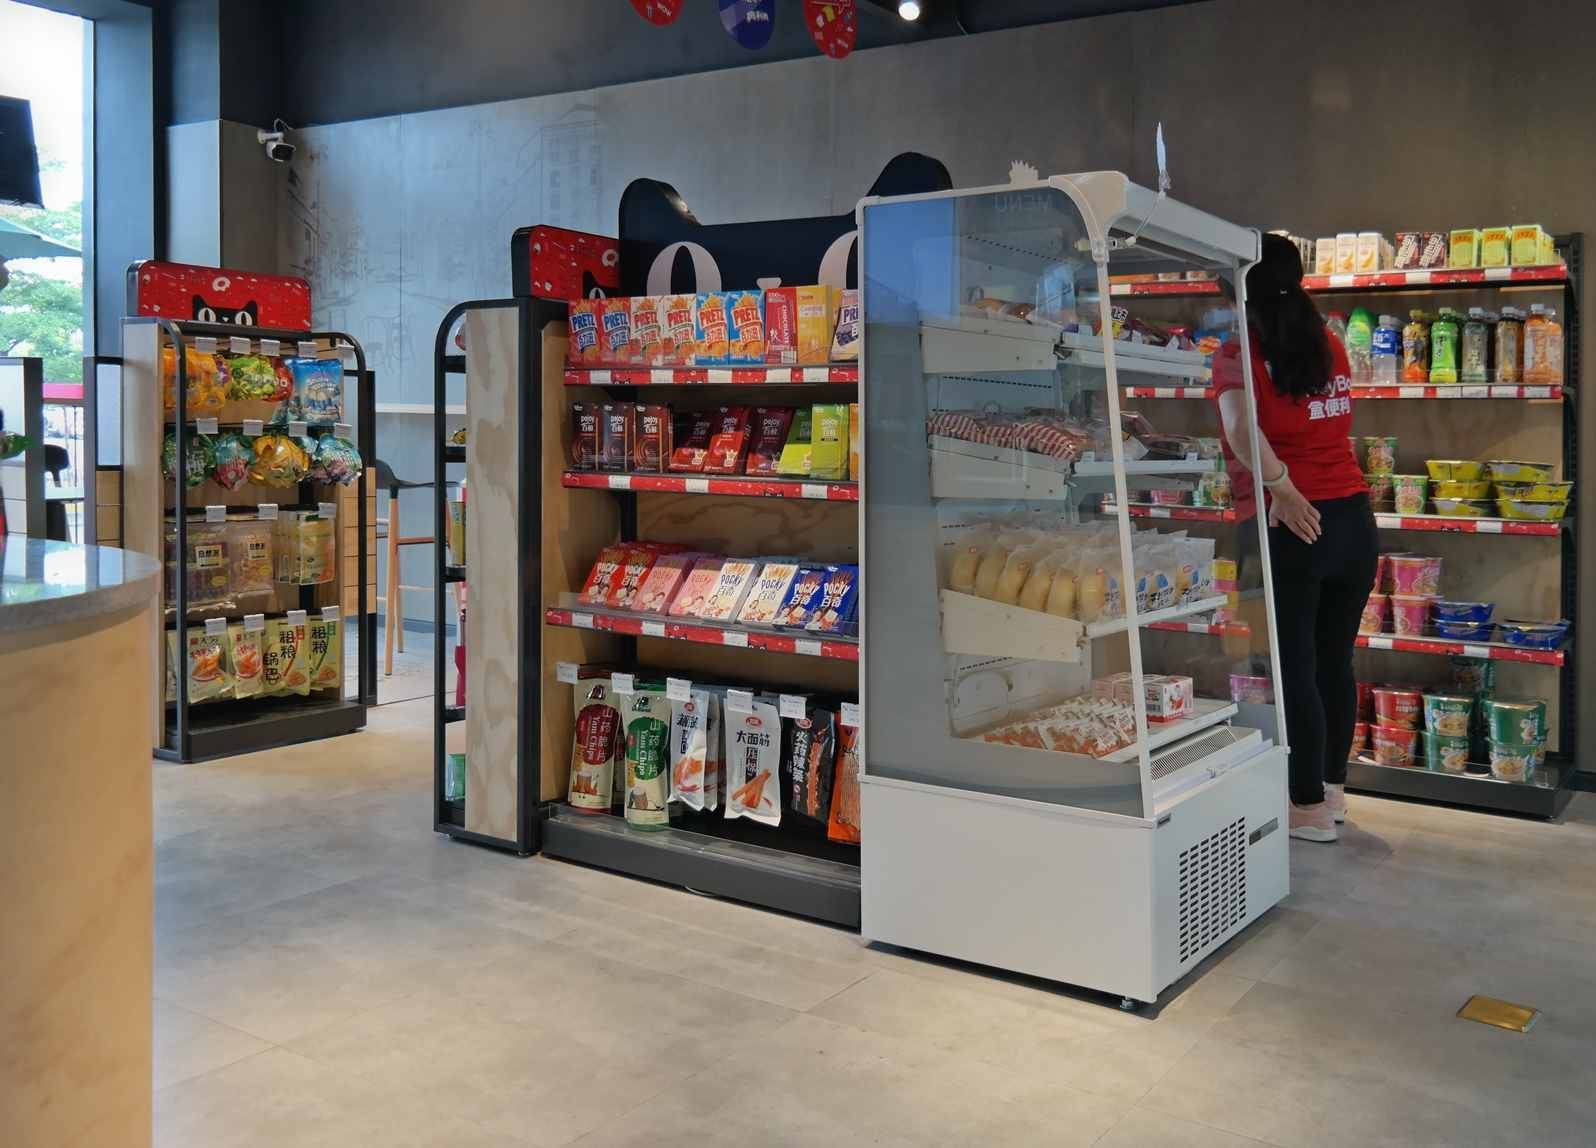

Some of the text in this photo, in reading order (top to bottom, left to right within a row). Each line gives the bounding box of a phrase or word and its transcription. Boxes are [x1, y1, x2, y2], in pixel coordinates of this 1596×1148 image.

[570, 311, 596, 332] PRETZ
[602, 311, 628, 331] PRETZ
[634, 309, 658, 328] PRETZ
[666, 309, 692, 328] PRETZ
[699, 306, 723, 327] PRETZ
[732, 306, 758, 327] PRETZ
[735, 729, 771, 748] 大面筋
